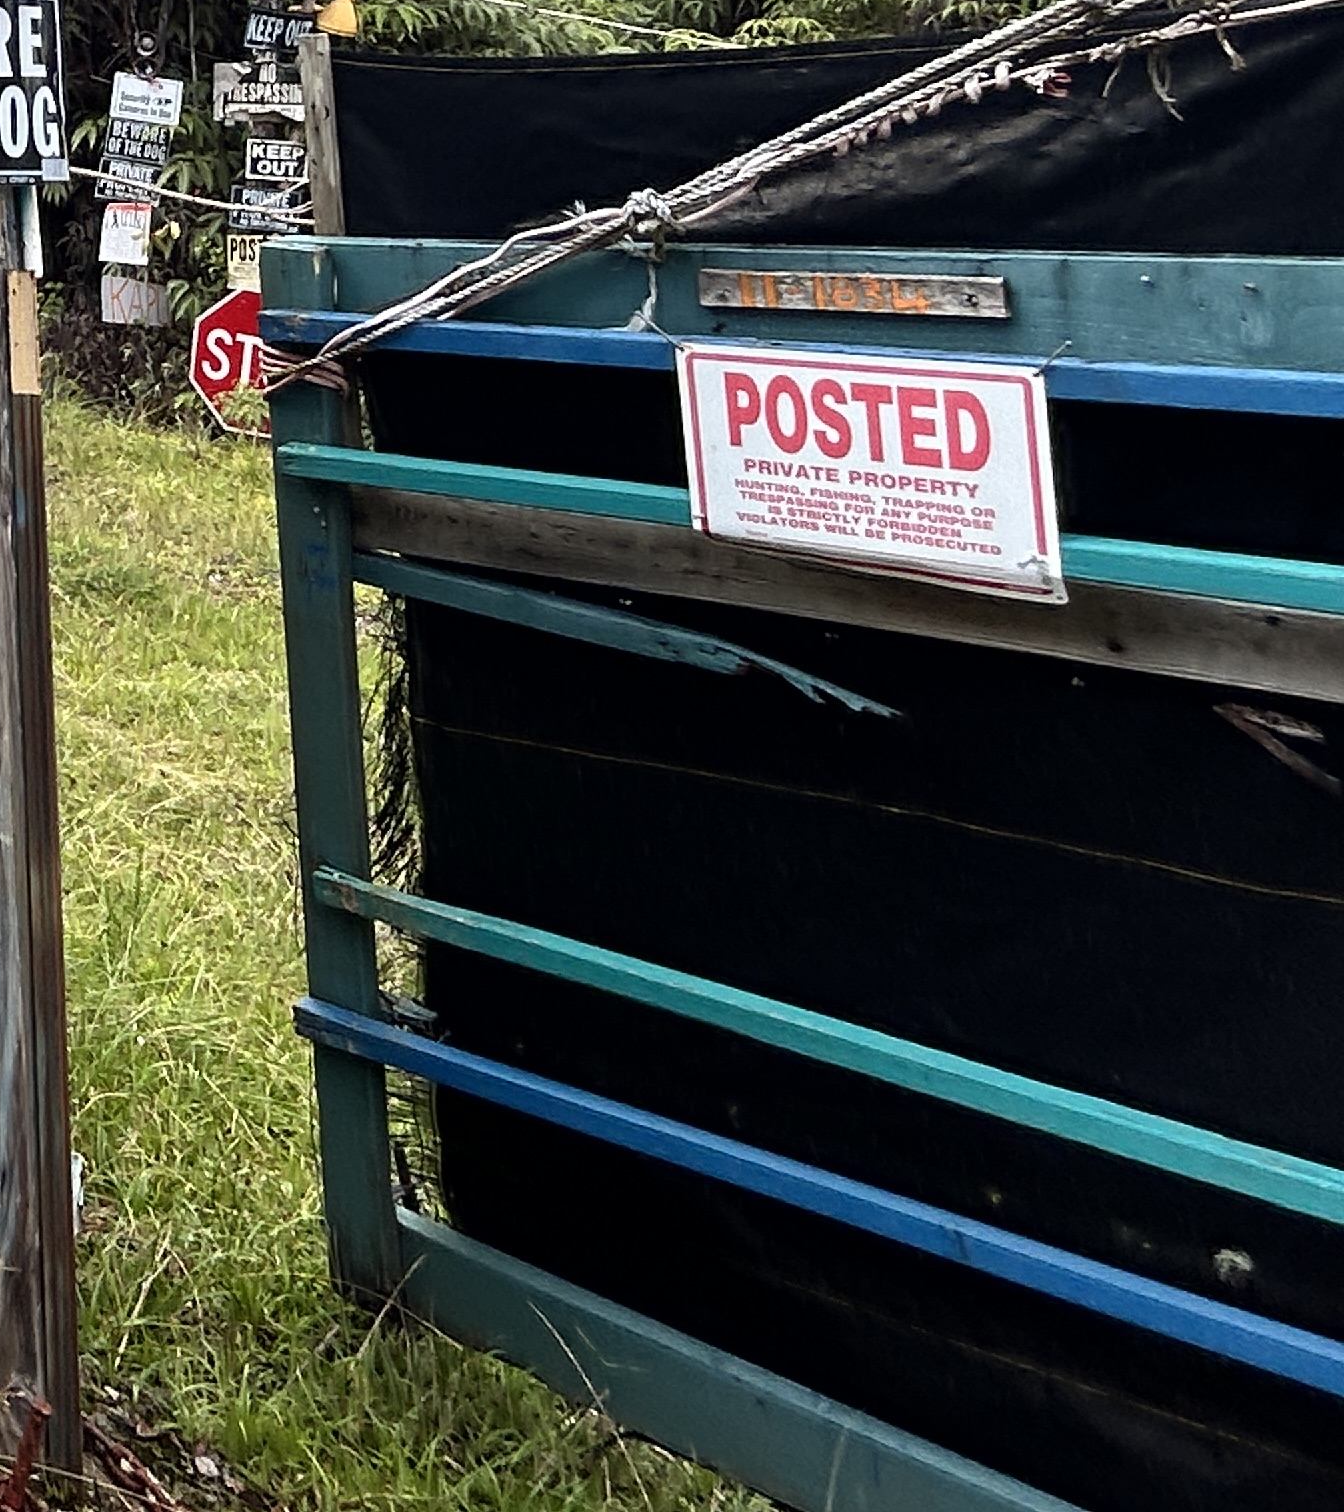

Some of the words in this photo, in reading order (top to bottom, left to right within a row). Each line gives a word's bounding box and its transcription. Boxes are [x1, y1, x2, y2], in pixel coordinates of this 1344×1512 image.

[246, 12, 284, 43] KEEP
[259, 63, 277, 83] NO
[108, 136, 122, 154] OF
[123, 138, 144, 158] THE
[144, 142, 167, 163] DOG
[251, 143, 305, 161] KEEP
[256, 160, 299, 177] OUT
[230, 238, 261, 262] POS
[201, 328, 265, 387] ST
[724, 371, 992, 472] POSTED
[744, 458, 840, 483] PRIVATE
[848, 470, 979, 498] PROPERTY
[739, 490, 839, 511] TRESPASSING
[844, 503, 875, 515] FOR
[881, 507, 911, 519] ANY
[917, 511, 994, 531] PURPOSE
[767, 504, 782, 515] IS
[786, 507, 861, 525] STRICTLY
[867, 518, 963, 538] FORBIDDEN
[881, 496, 965, 515] TRAPPING
[971, 506, 996, 519] OR
[736, 511, 820, 531] VIOLATORS
[824, 523, 859, 536] WILL
[864, 528, 886, 540] BE
[891, 532, 1002, 556] PROSECUTED
